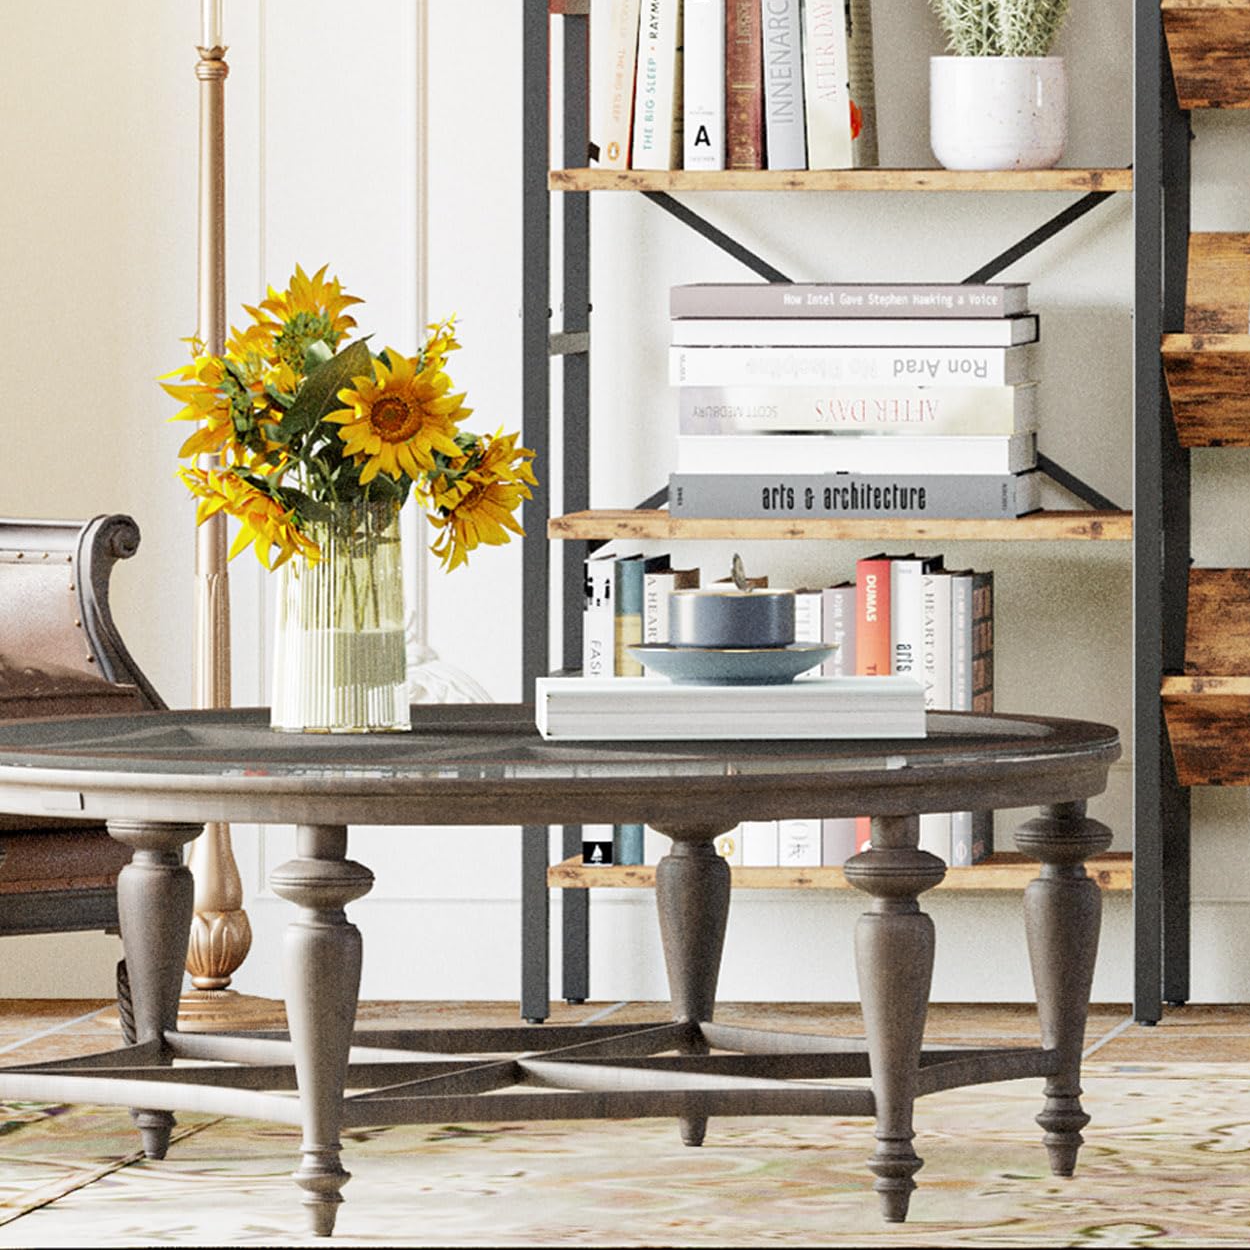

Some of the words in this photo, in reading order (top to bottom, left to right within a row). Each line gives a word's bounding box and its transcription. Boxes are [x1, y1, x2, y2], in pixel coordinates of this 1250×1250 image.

[646, 57, 657, 94] SLEEP
[644, 99, 655, 122] BIG
[643, 128, 653, 150] THE
[694, 125, 711, 147] A
[784, 294, 802, 305] How
[807, 294, 835, 305] Intel
[839, 295, 863, 305] Gave
[868, 294, 908, 307] Stephen
[913, 294, 953, 308] Hawking
[958, 297, 964, 305] a
[969, 294, 999, 305] Voice
[894, 359, 940, 377] Arad
[948, 359, 987, 377] Ron
[815, 399, 866, 423] DAYS
[877, 399, 940, 422] AFTER
[762, 484, 794, 511] arts
[805, 487, 815, 510] &
[824, 482, 926, 511] architecture
[924, 577, 934, 587] A
[866, 574, 877, 622] DUMAS
[648, 592, 658, 639] HEAR
[925, 593, 934, 648] HEART
[896, 644, 914, 672] arts
[925, 653, 934, 674] OF
